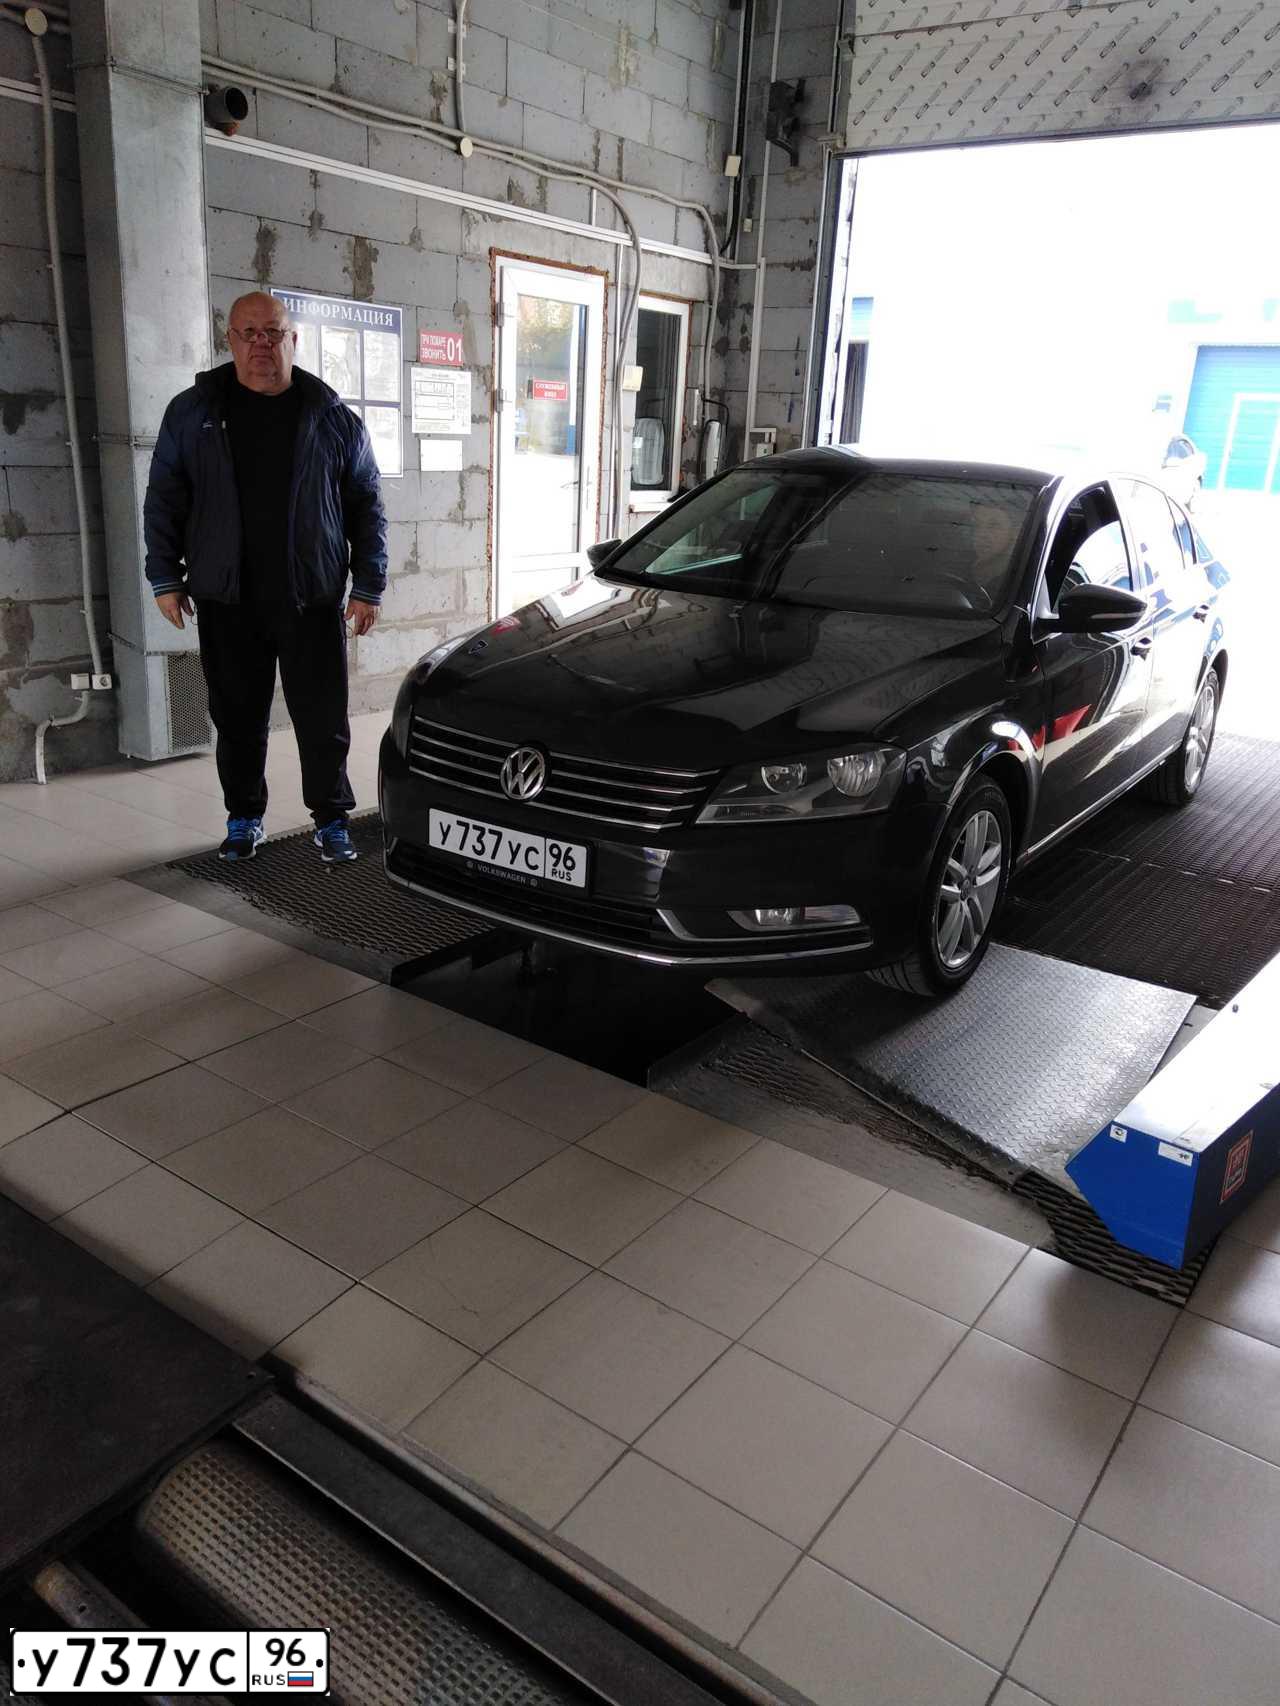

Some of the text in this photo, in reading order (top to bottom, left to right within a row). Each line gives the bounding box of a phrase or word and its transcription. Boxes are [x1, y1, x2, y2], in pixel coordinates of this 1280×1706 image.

[283, 297, 393, 326] ИНФОРМАЦИЯ
[421, 347, 447, 360] ЗВОНИТЬ
[447, 337, 462, 362] 01
[549, 843, 576, 871] 96
[477, 863, 526, 884] VOLKSWAGEN
[551, 868, 572, 882] RUS
